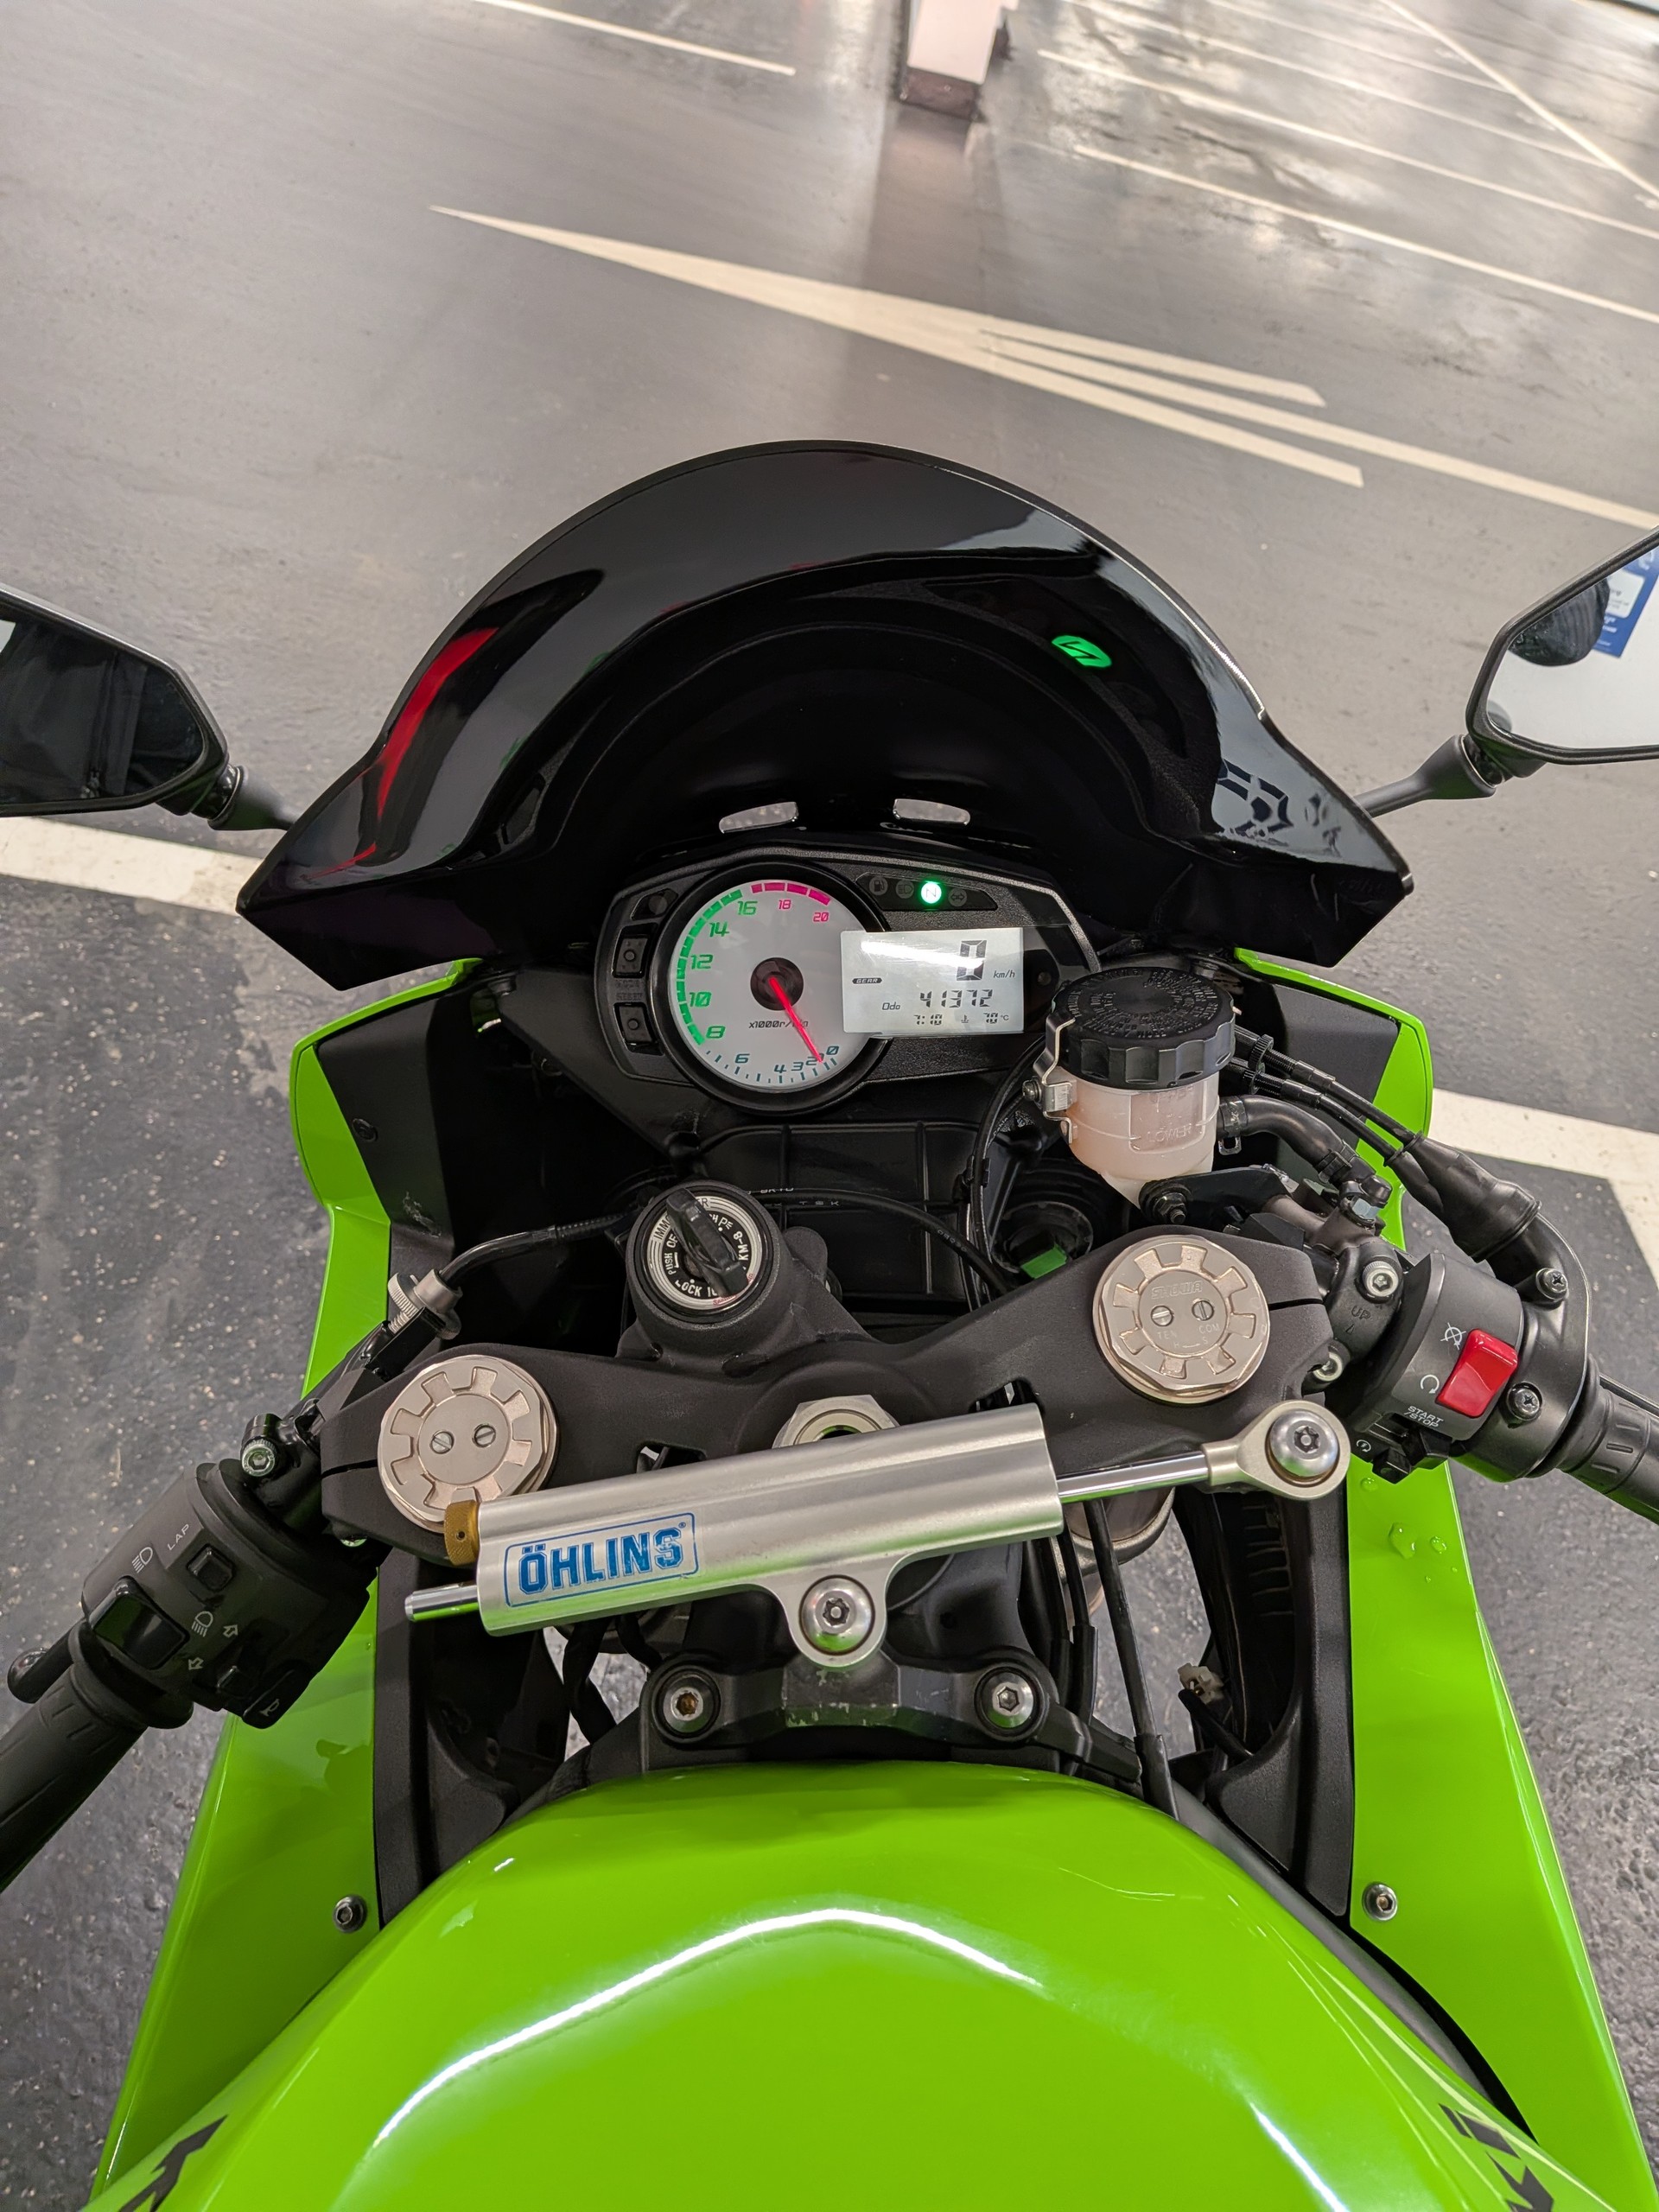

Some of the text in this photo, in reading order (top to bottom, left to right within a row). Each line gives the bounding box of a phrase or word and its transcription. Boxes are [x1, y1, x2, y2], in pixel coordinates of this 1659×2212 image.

[737, 900, 758, 915] 16
[779, 899, 791, 910] 18
[813, 912, 830, 922] 20
[709, 922, 729, 938] 14
[690, 954, 714, 969] 12
[993, 969, 1015, 979] km/h
[689, 991, 712, 1008] 10
[881, 989, 993, 1011] Odo 41372
[913, 1014, 943, 1026] 7:10
[705, 1026, 726, 1039] 8
[826, 1046, 840, 1055] 0
[734, 1053, 750, 1064] 6
[773, 1065, 787, 1074] 4
[791, 1062, 804, 1071] 3
[664, 1252, 677, 1275] PUSH
[675, 1280, 702, 1297] LOCK
[1151, 1280, 1203, 1300] SHOWA
[1351, 1305, 1371, 1321] UP
[1408, 1405, 1444, 1425] START
[167, 1523, 190, 1552] LAP
